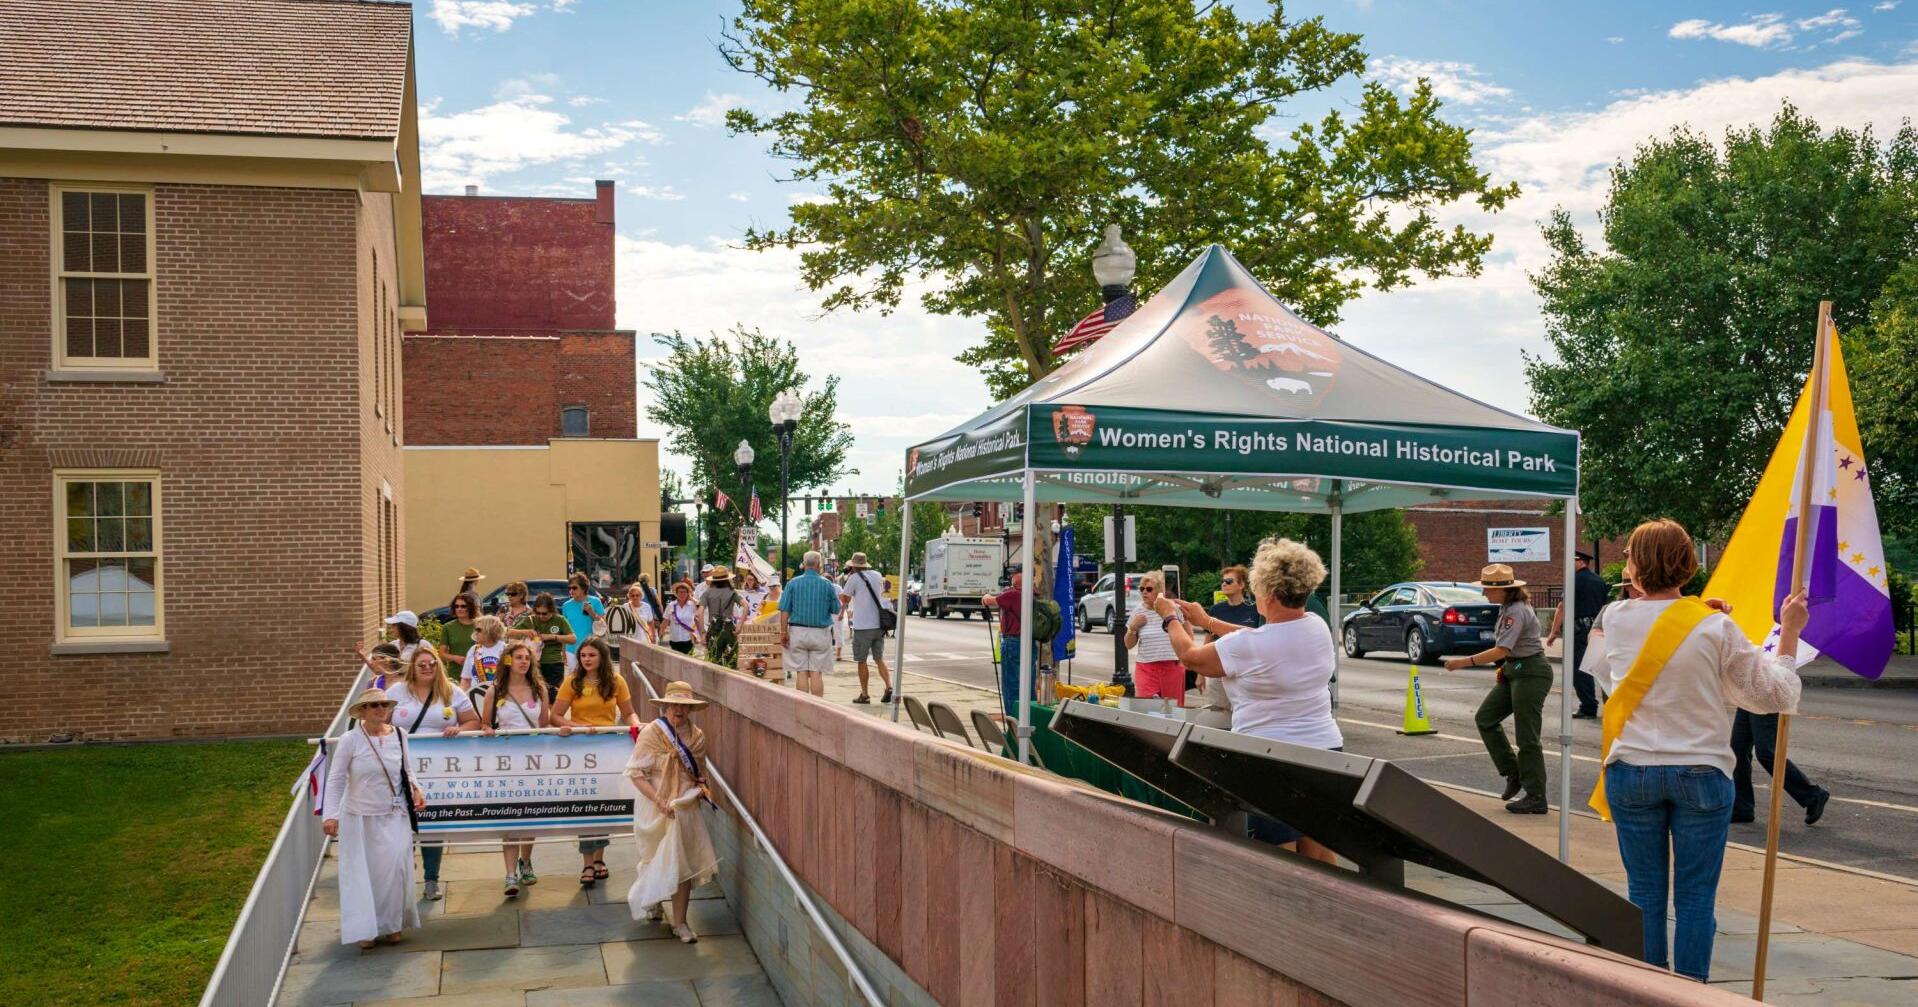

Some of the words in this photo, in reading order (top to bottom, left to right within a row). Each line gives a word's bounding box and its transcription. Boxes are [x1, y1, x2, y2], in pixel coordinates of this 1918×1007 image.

[916, 456, 937, 477] Women's
[937, 449, 955, 471] Rights
[955, 441, 979, 462] National
[976, 435, 1005, 456] Historical
[1004, 429, 1020, 450] Park
[1099, 428, 1206, 449] Women's
[1214, 430, 1289, 455] Rights
[1295, 432, 1388, 458] National
[1396, 440, 1500, 468] Historical
[1508, 450, 1557, 473] Park
[1491, 530, 1524, 538] LIBERTY
[1064, 530, 1073, 601] CONVENTION
[1413, 676, 1424, 719] POLICE
[416, 753, 598, 773] FRIENDS
[447, 779, 525, 789] WOMEN'S
[537, 777, 598, 787] RIGHTS
[425, 791, 480, 800] ATIONAL
[485, 788, 560, 799] HISTORICAL
[566, 787, 598, 796] PARK
[439, 809, 454, 817] the
[454, 808, 474, 817] Past
[524, 805, 569, 816] Inspiration
[571, 803, 584, 814] for
[585, 803, 600, 813] the
[599, 803, 627, 812] Future
